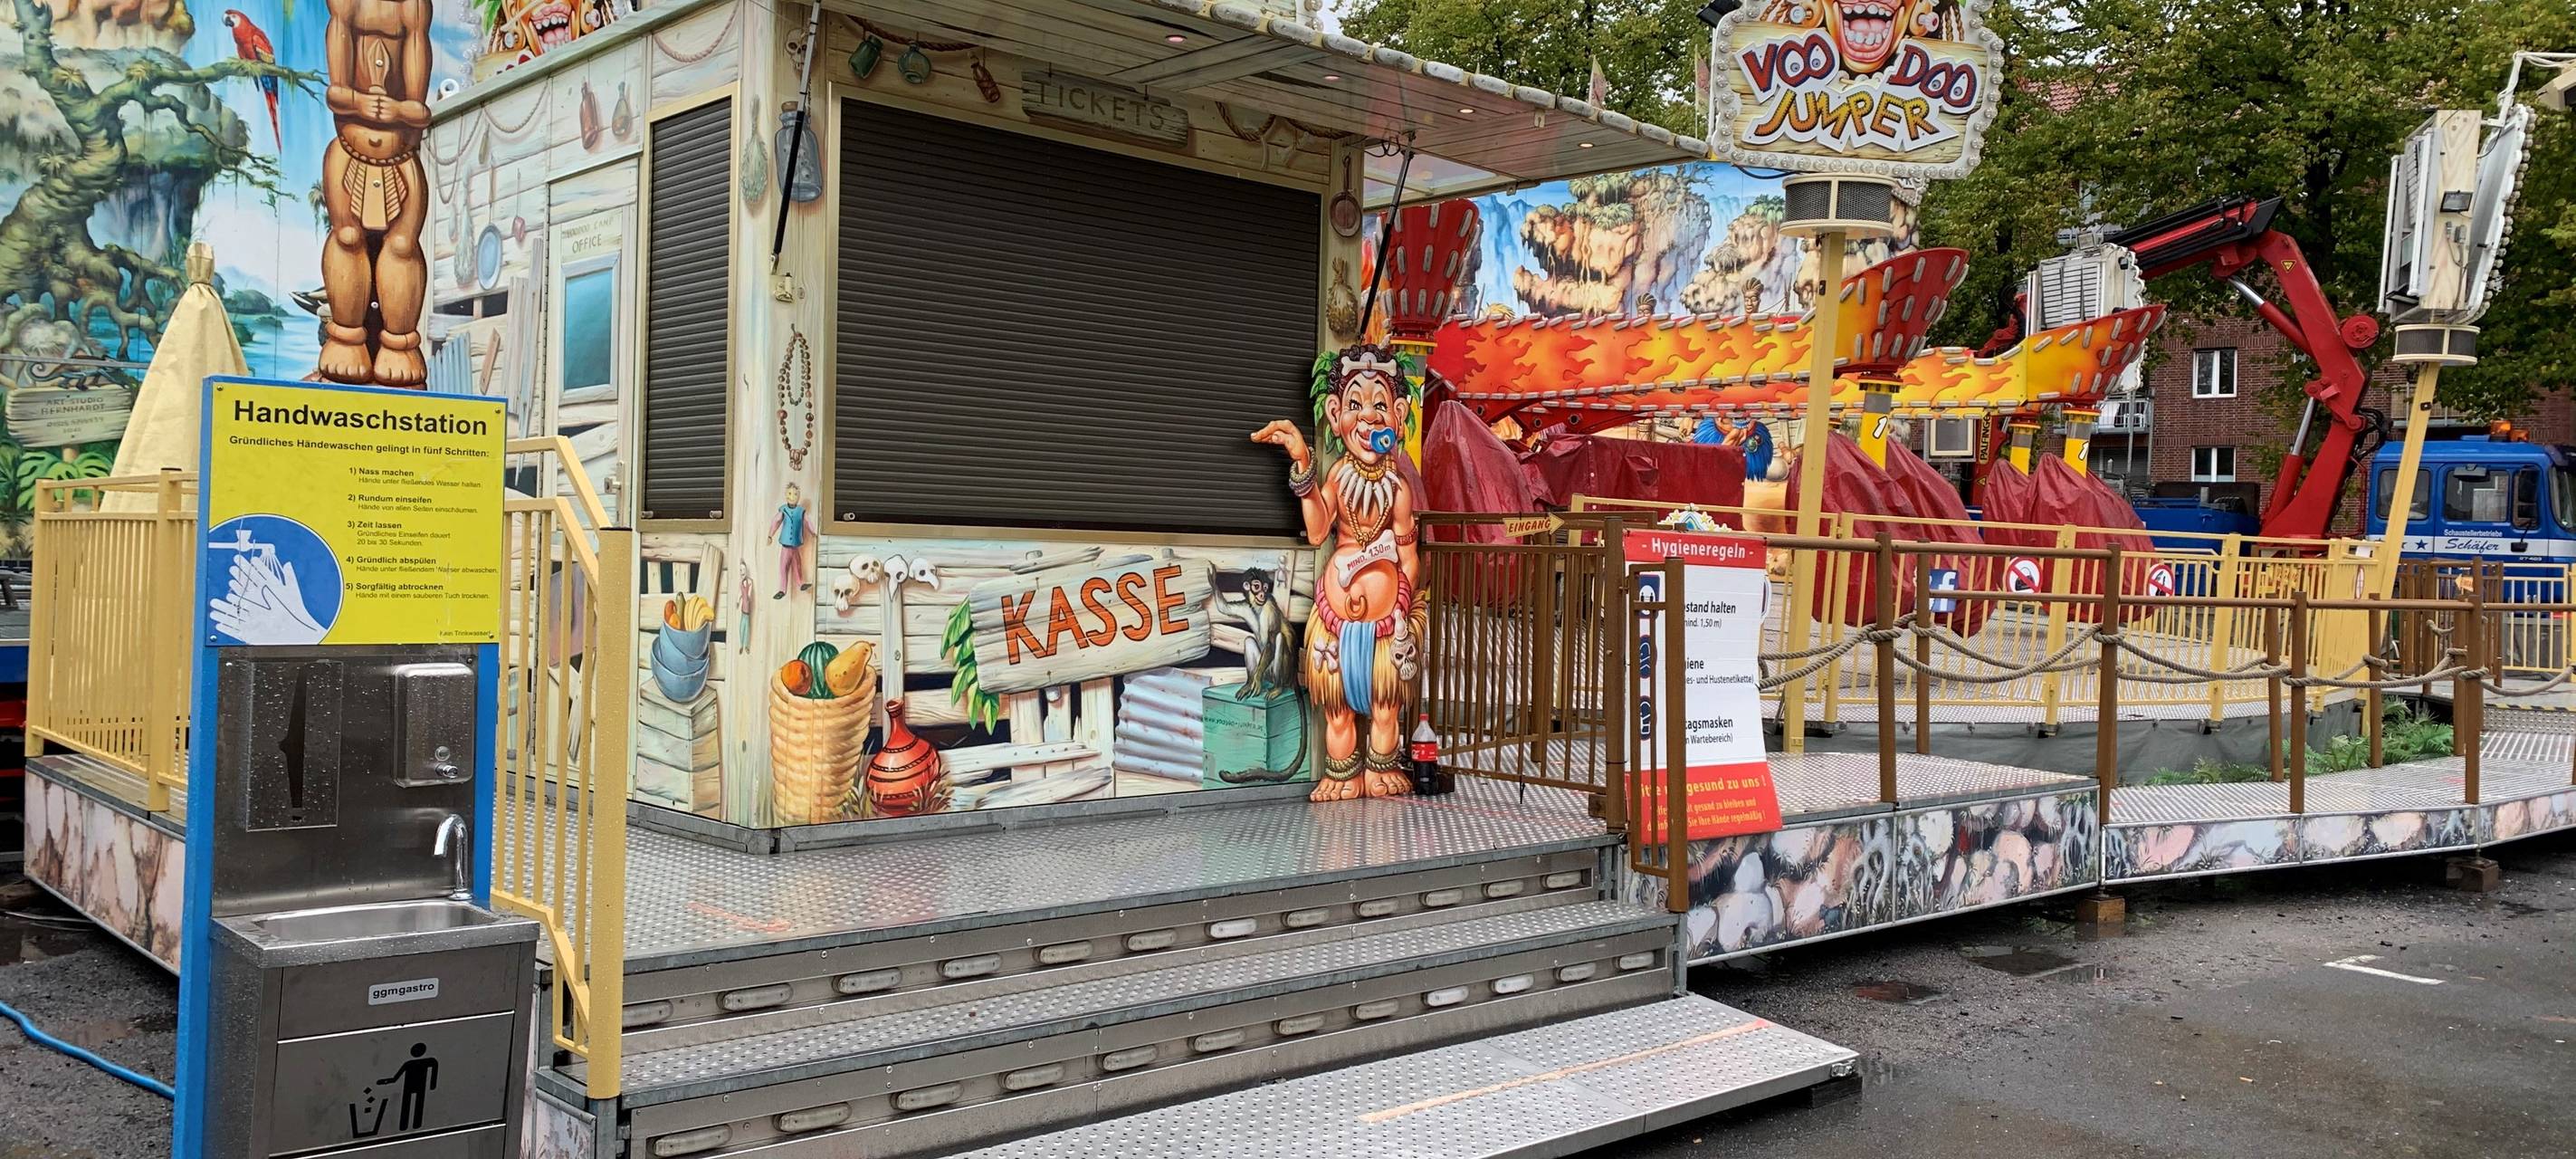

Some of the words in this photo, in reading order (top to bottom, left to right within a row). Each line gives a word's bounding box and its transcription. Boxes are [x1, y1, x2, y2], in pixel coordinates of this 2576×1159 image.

[1742, 34, 1836, 91] VOO
[1887, 43, 1977, 108] DOO
[1035, 81, 1164, 130] TICKETS
[1754, 90, 1940, 141] JUMPER
[572, 234, 602, 254] OFFICE
[234, 399, 487, 436] Handwaschstation
[229, 436, 294, 447] Gründliches
[297, 438, 374, 451] Händewaschen
[376, 444, 409, 455] gelingt
[412, 445, 421, 454] in
[423, 445, 443, 455] fünf
[444, 446, 490, 457] Schritten:
[348, 467, 357, 475] 1)
[358, 467, 379, 475] Nass
[382, 468, 414, 476] machen
[358, 494, 393, 503] Rundum
[396, 495, 432, 503] einseifen
[348, 521, 355, 529] 3)
[1509, 518, 1550, 533] EINGANG
[2444, 529, 2503, 538] Schaustellerbetriebe
[1652, 538, 1746, 561] Hygieneregeln
[2445, 539, 2499, 553] Schäfer
[346, 556, 354, 564] 4)
[357, 556, 397, 564] Gründlich
[399, 557, 436, 565] abspülen
[1347, 554, 1368, 570] MIND.
[356, 582, 396, 591] Sorgfältig
[1001, 564, 1189, 666] KASSE
[1684, 601, 1710, 614] stand
[1711, 602, 1736, 614] halten
[1700, 619, 1713, 628] 1,50
[1713, 619, 1722, 629] m)
[1685, 658, 1704, 670] iene
[1686, 676, 1695, 685] es-
[1696, 675, 1708, 685] und
[1709, 675, 1754, 685] Hustenetikette)
[1684, 716, 1733, 732] tagsmasken
[1691, 733, 1733, 744] Wartebereich)
[1686, 778, 1725, 796] gesund
[1727, 780, 1739, 790] zu
[1741, 778, 1760, 789] uns
[1693, 801, 1715, 814] gesund
[1745, 797, 1757, 807] und
[373, 983, 434, 999] ggmgastro
